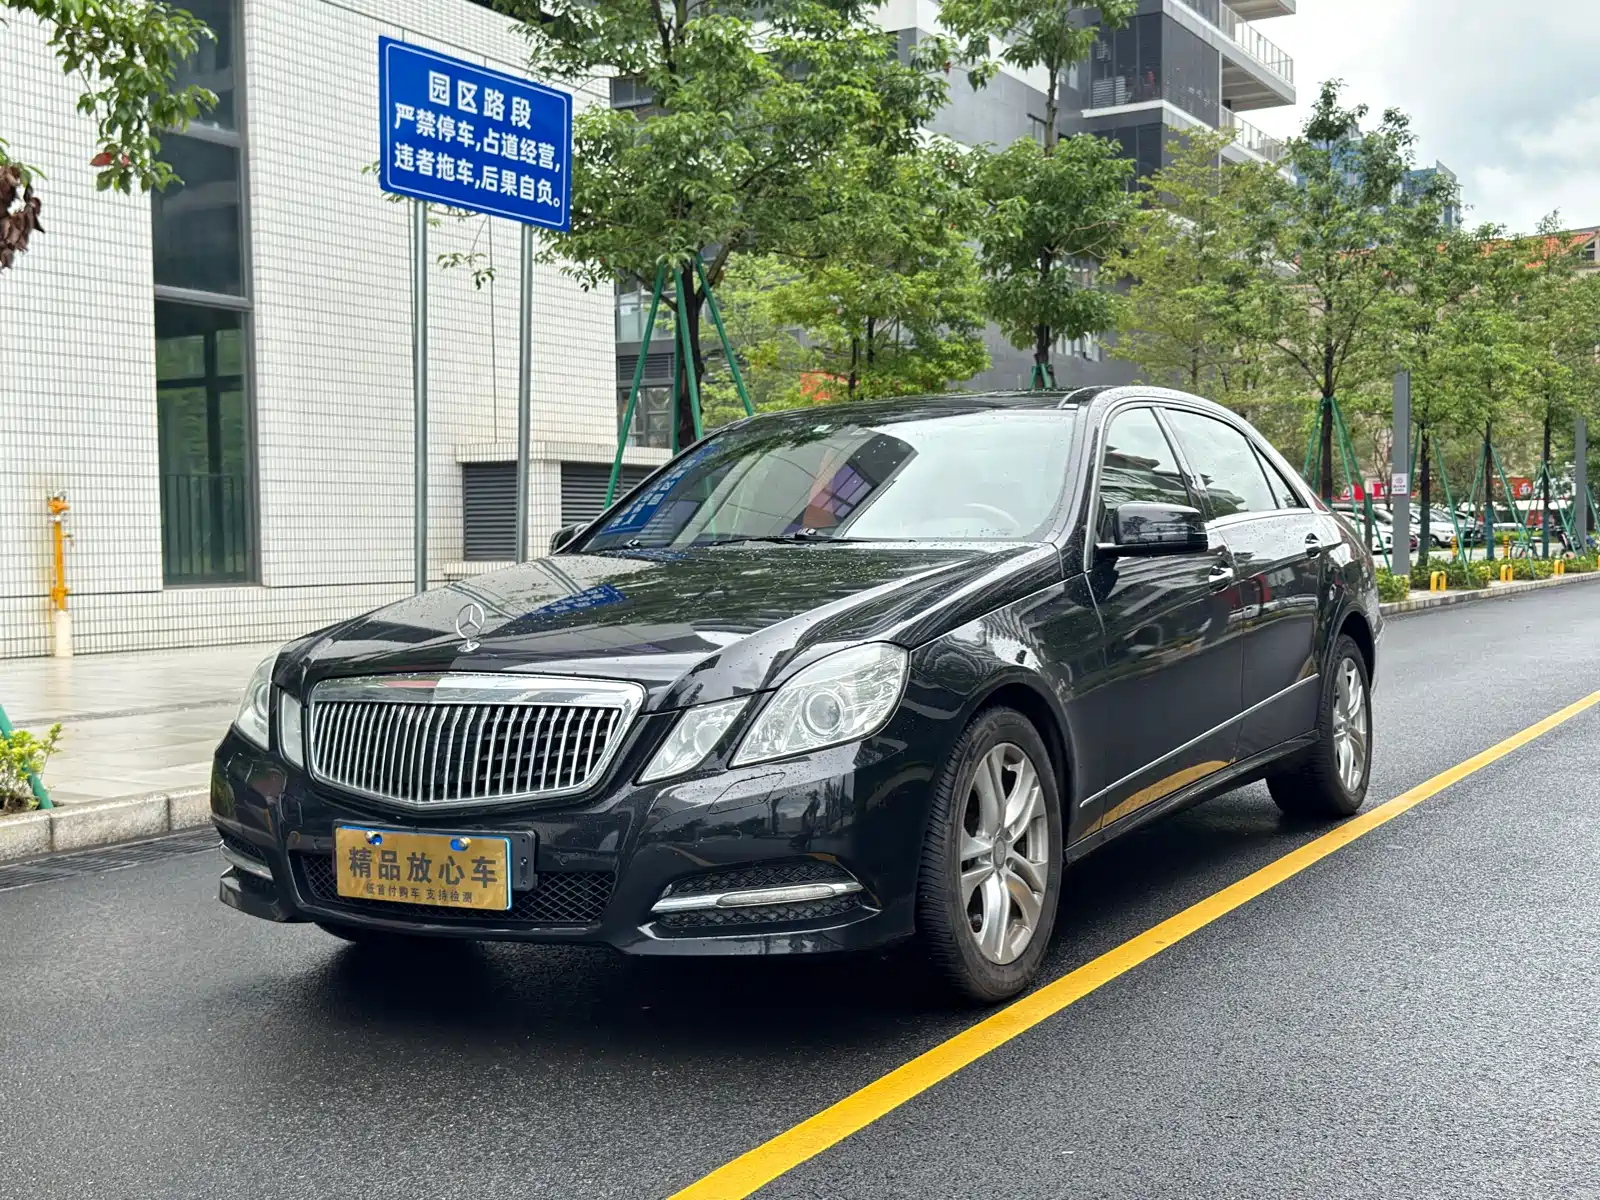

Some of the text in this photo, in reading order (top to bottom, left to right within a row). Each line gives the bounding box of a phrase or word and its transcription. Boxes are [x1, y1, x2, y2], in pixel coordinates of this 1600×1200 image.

[428, 70, 532, 130] 园区路段
[394, 102, 561, 173] 严禁停车，占道经营，
[394, 142, 561, 208] 违者拖车，后果自负。
[348, 846, 498, 888] 精品放心车
[426, 888, 473, 904] 支持检测
